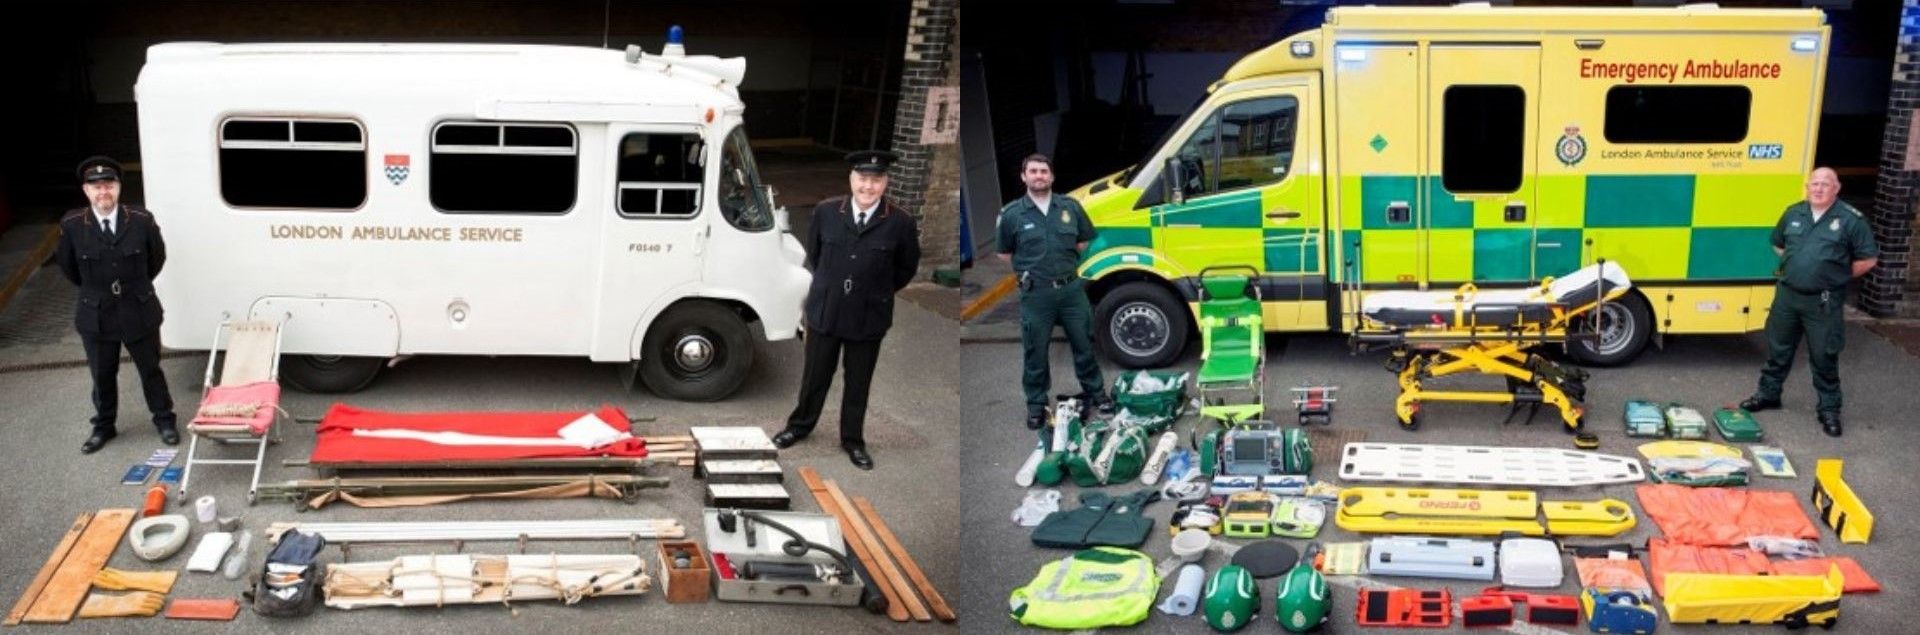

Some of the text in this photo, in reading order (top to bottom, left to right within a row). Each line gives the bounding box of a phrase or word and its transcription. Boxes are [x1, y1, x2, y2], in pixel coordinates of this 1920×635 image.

[1580, 58, 1781, 82] Emergency Ambulance
[1601, 148, 1743, 159] London Ambulance Service
[1749, 144, 1782, 159] NHS
[271, 225, 523, 241] LONDON AMBULANCE SERVICE
